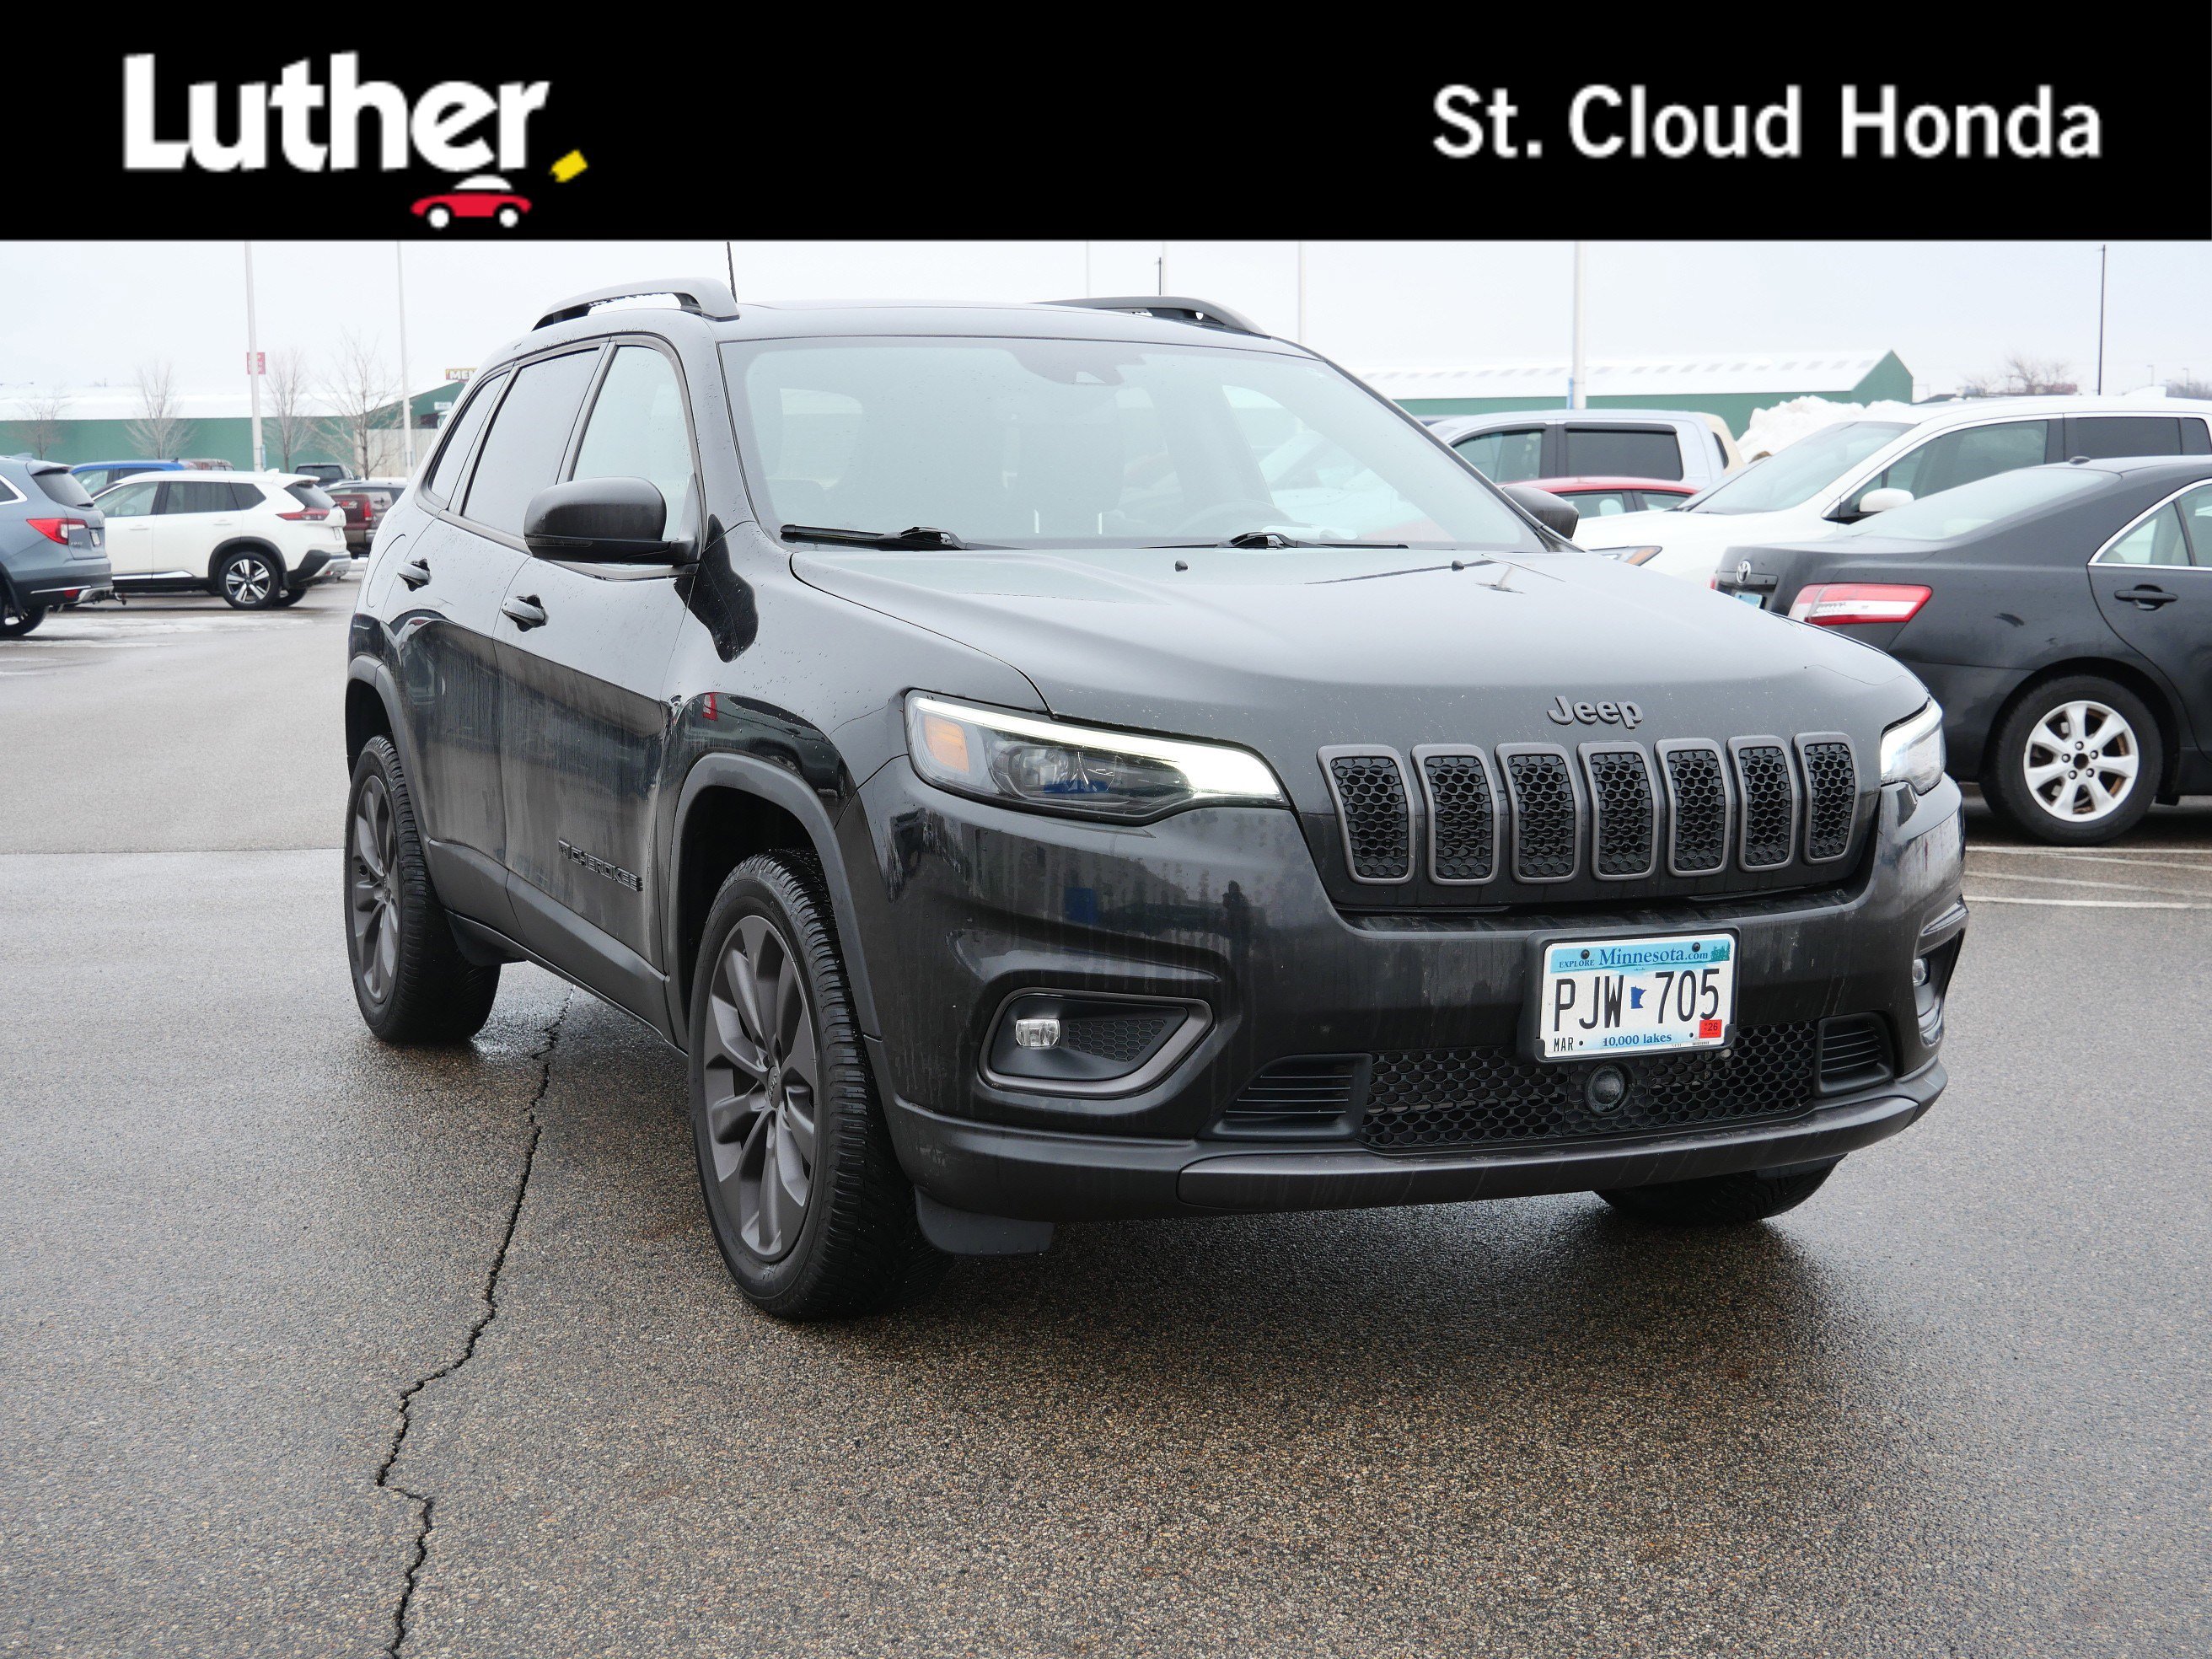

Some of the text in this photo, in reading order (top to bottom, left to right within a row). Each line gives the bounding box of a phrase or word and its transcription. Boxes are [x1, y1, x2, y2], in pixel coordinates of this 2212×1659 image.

[1547, 695, 1644, 729] Jeep
[571, 846, 642, 892] CHEROKEE
[1559, 958, 1595, 968] EXPLORE
[1554, 968, 1721, 1032] PJW 705
[1707, 1023, 1718, 1032] 26
[1554, 1037, 1574, 1052] MAR
[1603, 1033, 1672, 1048] 10,000 lakes
